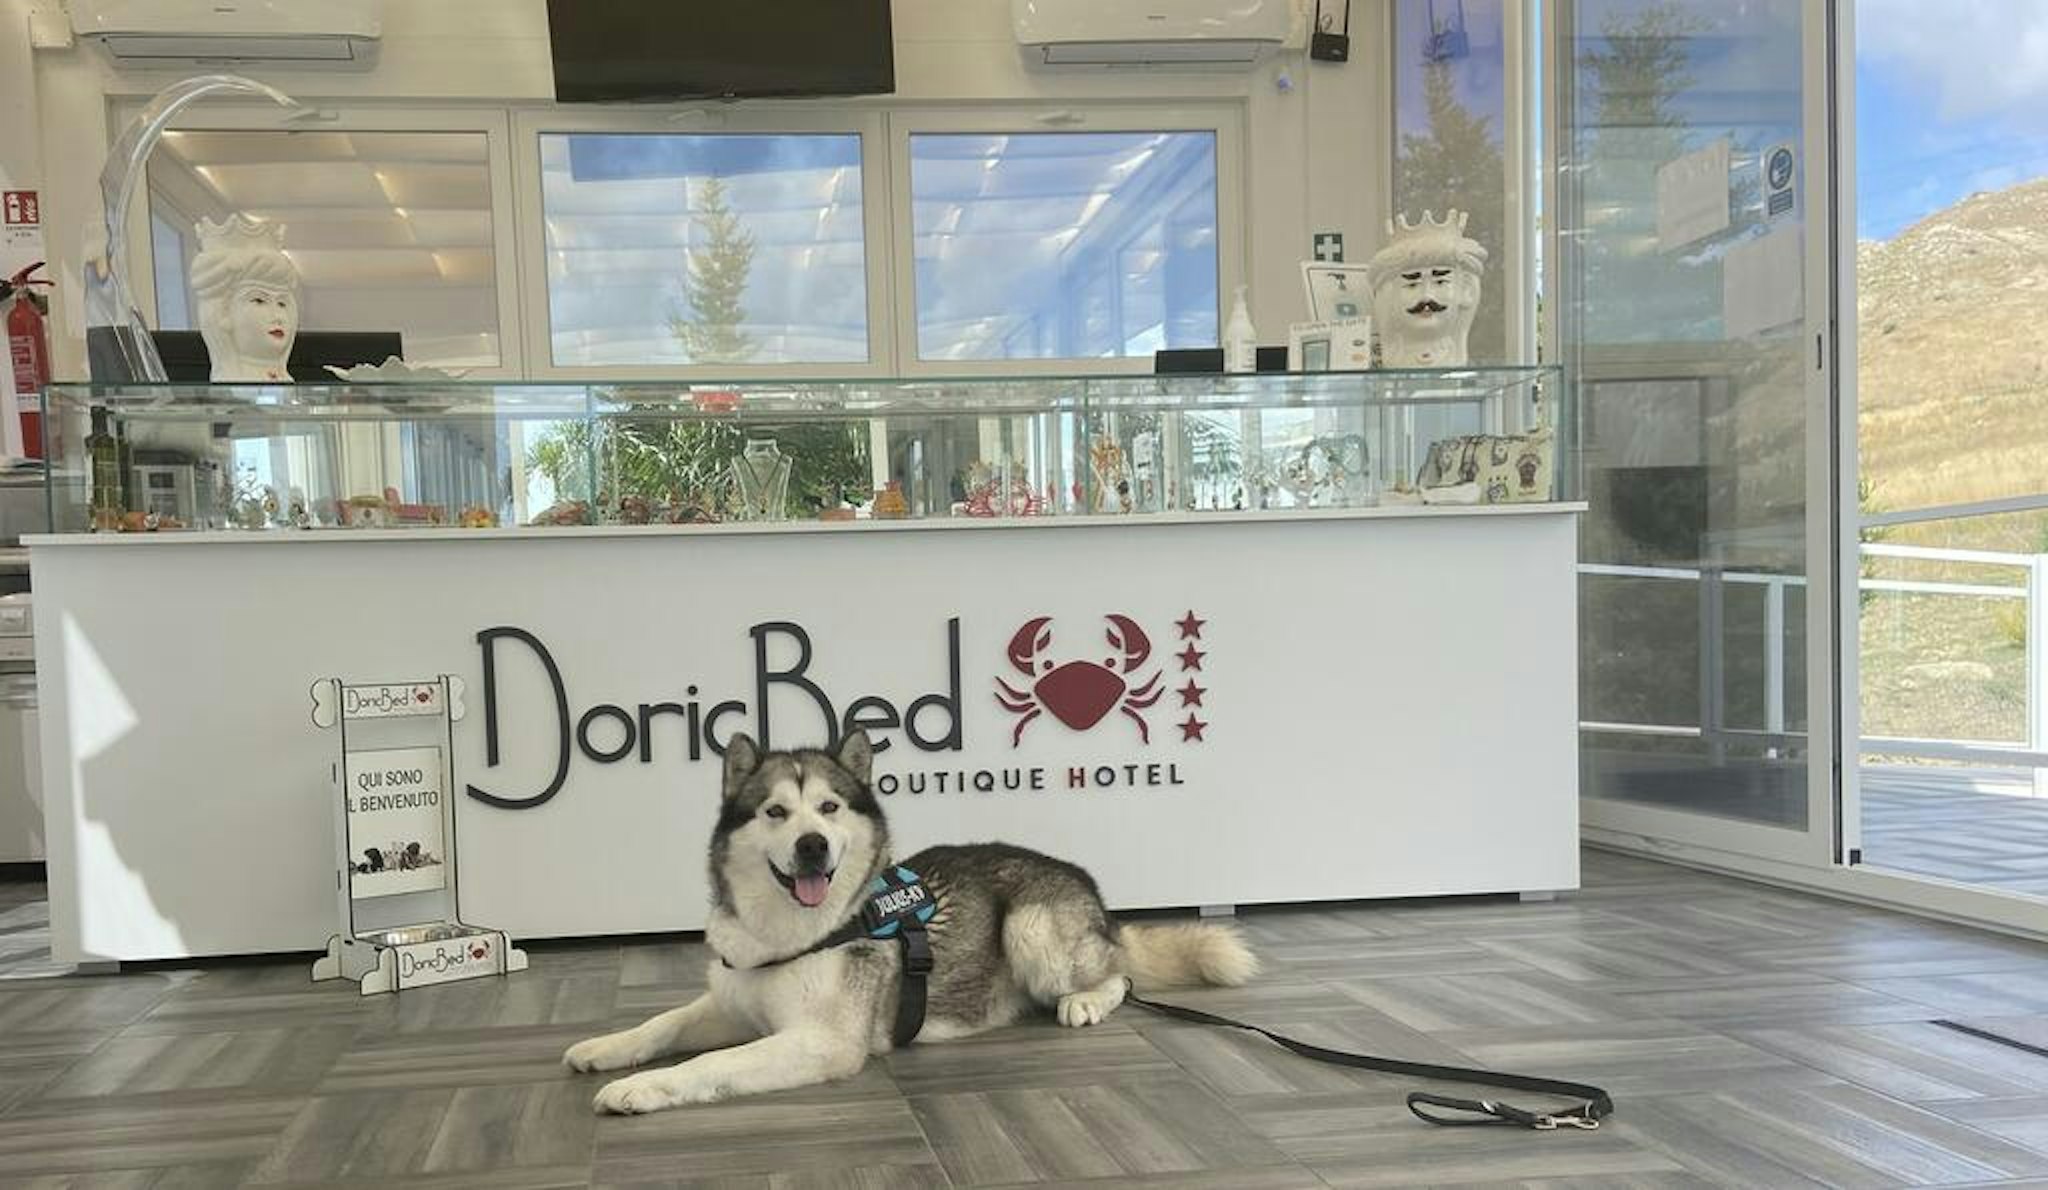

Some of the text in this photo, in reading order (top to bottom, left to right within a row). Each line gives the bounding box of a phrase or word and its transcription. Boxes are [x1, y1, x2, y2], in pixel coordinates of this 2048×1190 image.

[466, 617, 963, 810] DoricBed
[358, 769, 423, 792] QUI SONO
[877, 763, 1185, 796] OUTIQUE HOTEL
[360, 791, 439, 813] BENVENUTO
